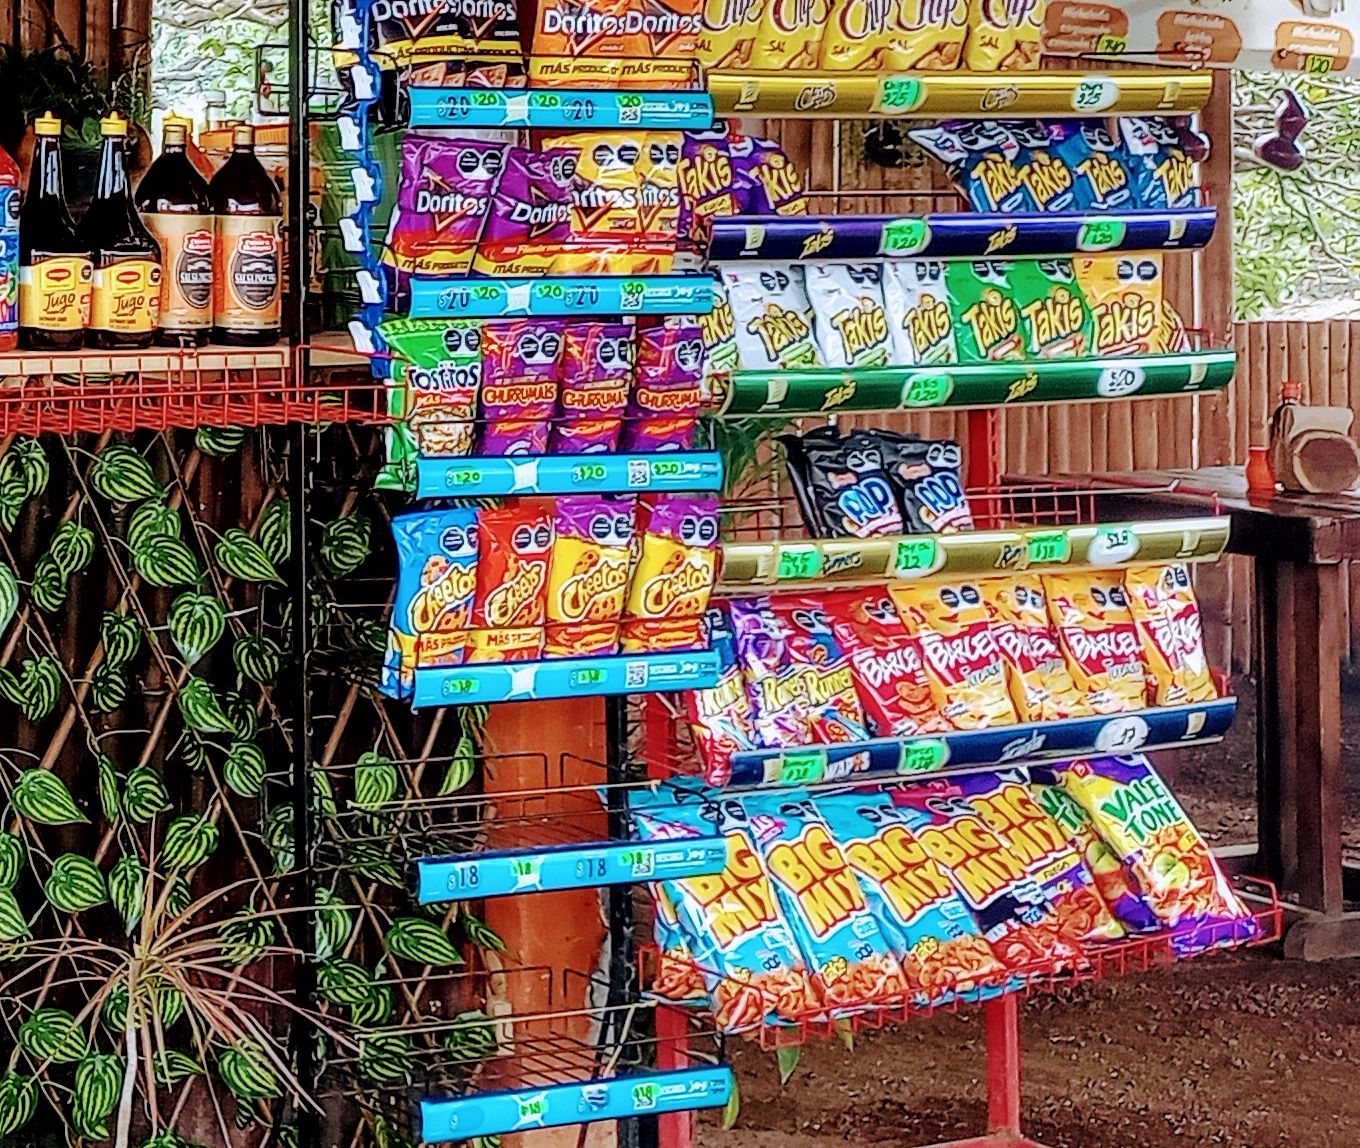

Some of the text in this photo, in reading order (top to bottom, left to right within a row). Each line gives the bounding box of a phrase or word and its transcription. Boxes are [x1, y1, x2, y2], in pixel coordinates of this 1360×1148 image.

[544, 7, 628, 36] Doritos
[626, 8, 704, 35] Doritos
[1307, 56, 1331, 74] 120
[416, 191, 488, 217] Doritos
[971, 158, 1021, 212] Takis
[1019, 158, 1072, 213] Takis
[511, 200, 574, 226] Doritos
[42, 292, 76, 314] Jugo
[112, 293, 145, 316] Jugo
[961, 297, 1018, 360] Takis
[1022, 297, 1083, 357] Takis
[1091, 299, 1158, 350] Takis
[748, 308, 812, 360] Takis
[832, 305, 887, 364] Takis
[904, 304, 951, 365] Takis
[407, 364, 479, 391] TOSTITOS
[483, 382, 558, 408] CHURRUMAIS
[410, 565, 477, 624] Cheetos
[562, 561, 628, 616] Cheetos
[646, 561, 710, 616] Cheetos
[979, 784, 1042, 833] BIG
[768, 826, 846, 893] BIG
[847, 827, 929, 881] BIG
[920, 817, 1001, 869] BIG
[1006, 815, 1068, 864] MIX
[881, 858, 954, 924] MIX
[953, 845, 1026, 905] MIX
[799, 867, 865, 938] MIX
